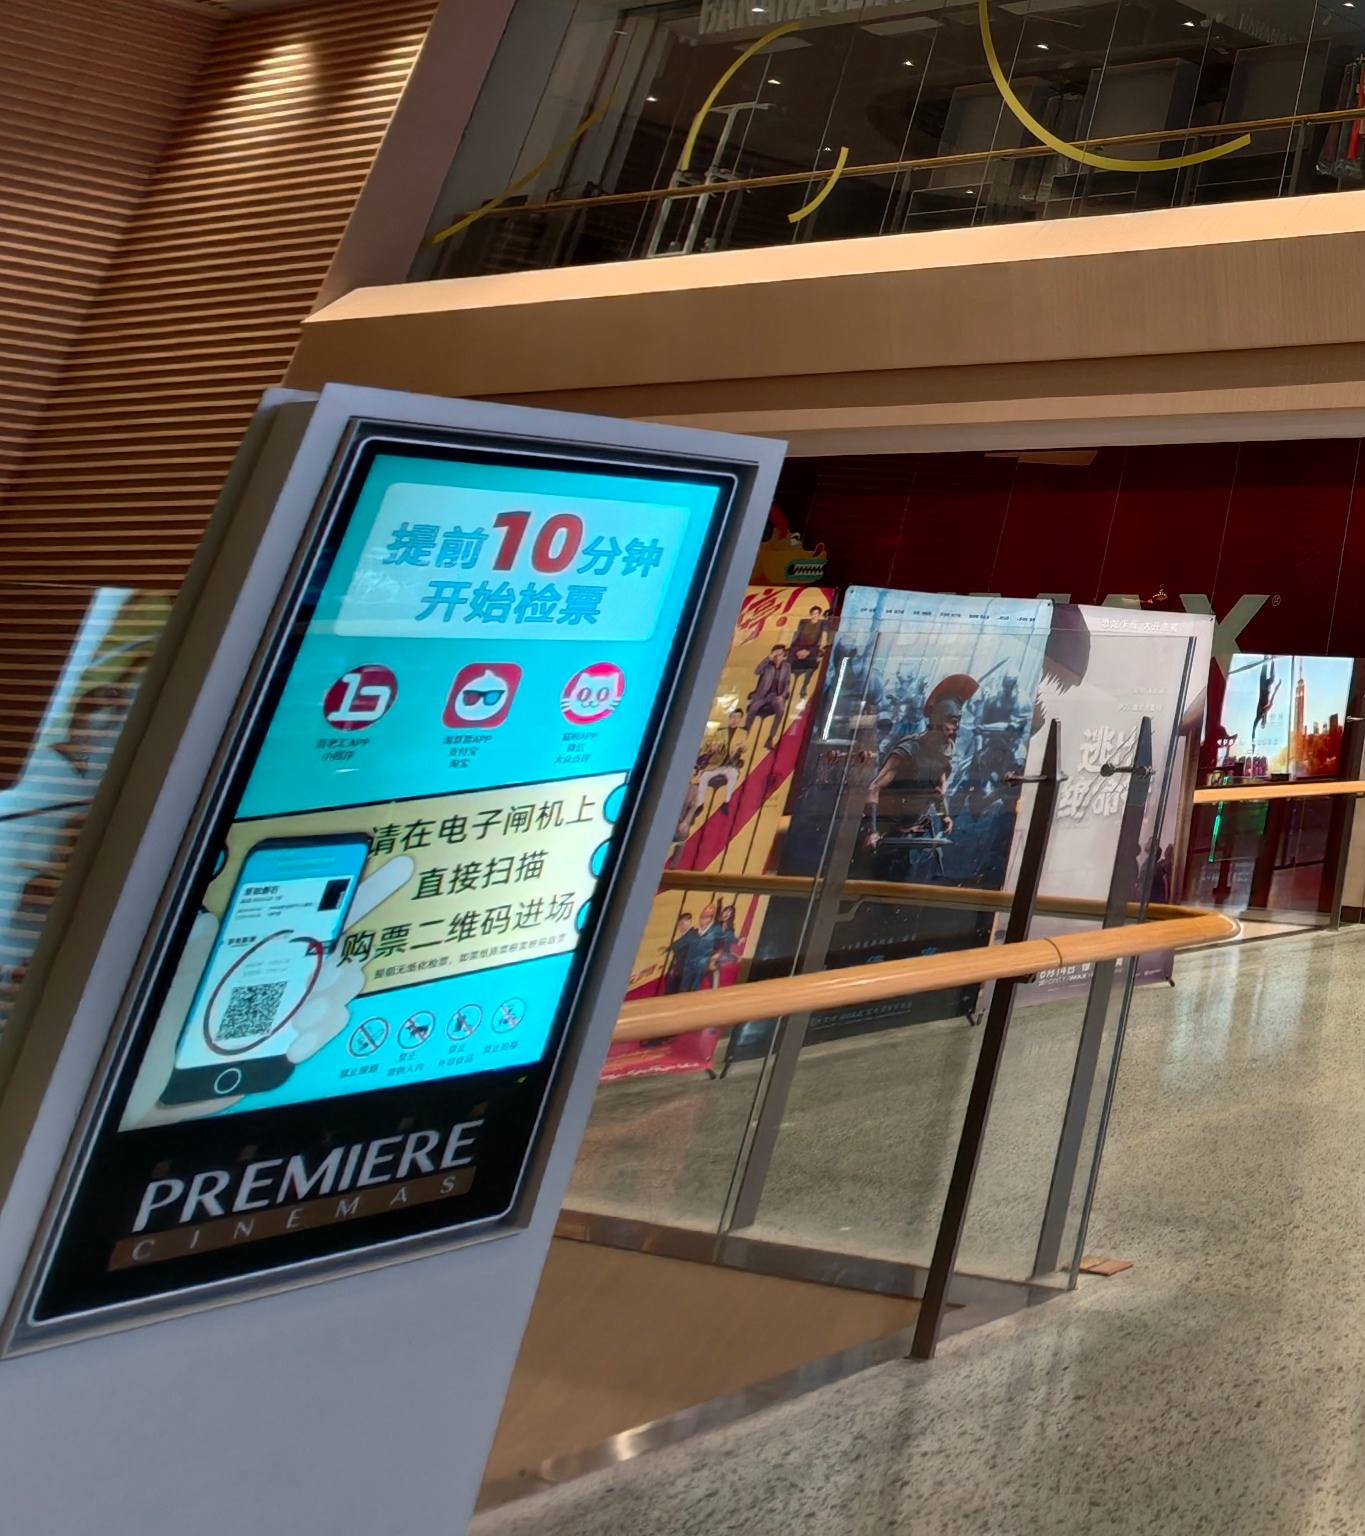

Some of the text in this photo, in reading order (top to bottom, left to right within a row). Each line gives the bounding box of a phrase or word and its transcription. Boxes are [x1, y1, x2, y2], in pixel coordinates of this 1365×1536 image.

[382, 510, 665, 578] 提前10分钟
[415, 580, 608, 626] 开始检票
[367, 794, 596, 860] 请在电子闸机上
[410, 848, 549, 902] 直接扫描
[336, 891, 576, 969] 购票二维码进场
[131, 1118, 486, 1233] PREMIERE
[131, 1175, 458, 1262] CINEMAS
